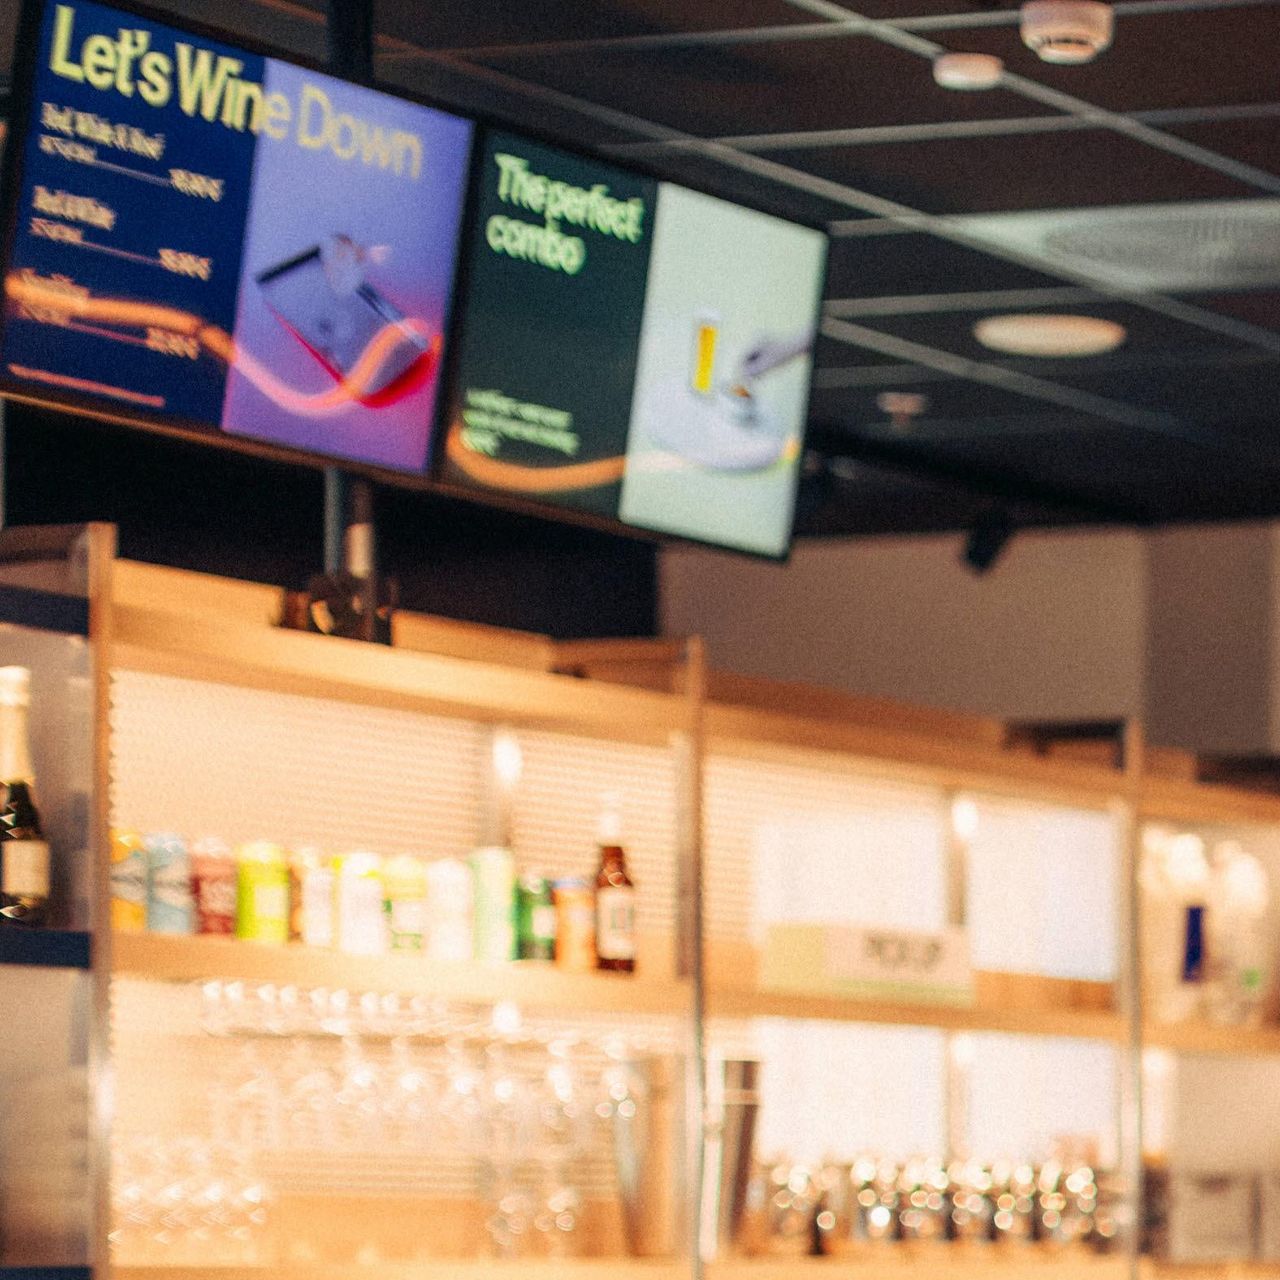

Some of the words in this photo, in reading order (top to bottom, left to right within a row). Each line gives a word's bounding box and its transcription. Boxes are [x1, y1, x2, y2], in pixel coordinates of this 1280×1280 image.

[48, 4, 172, 108] Let's
[175, 42, 291, 140] Wine
[300, 85, 424, 180] Down
[494, 152, 548, 215] The
[545, 180, 645, 244] perfect
[486, 214, 586, 275] combo
